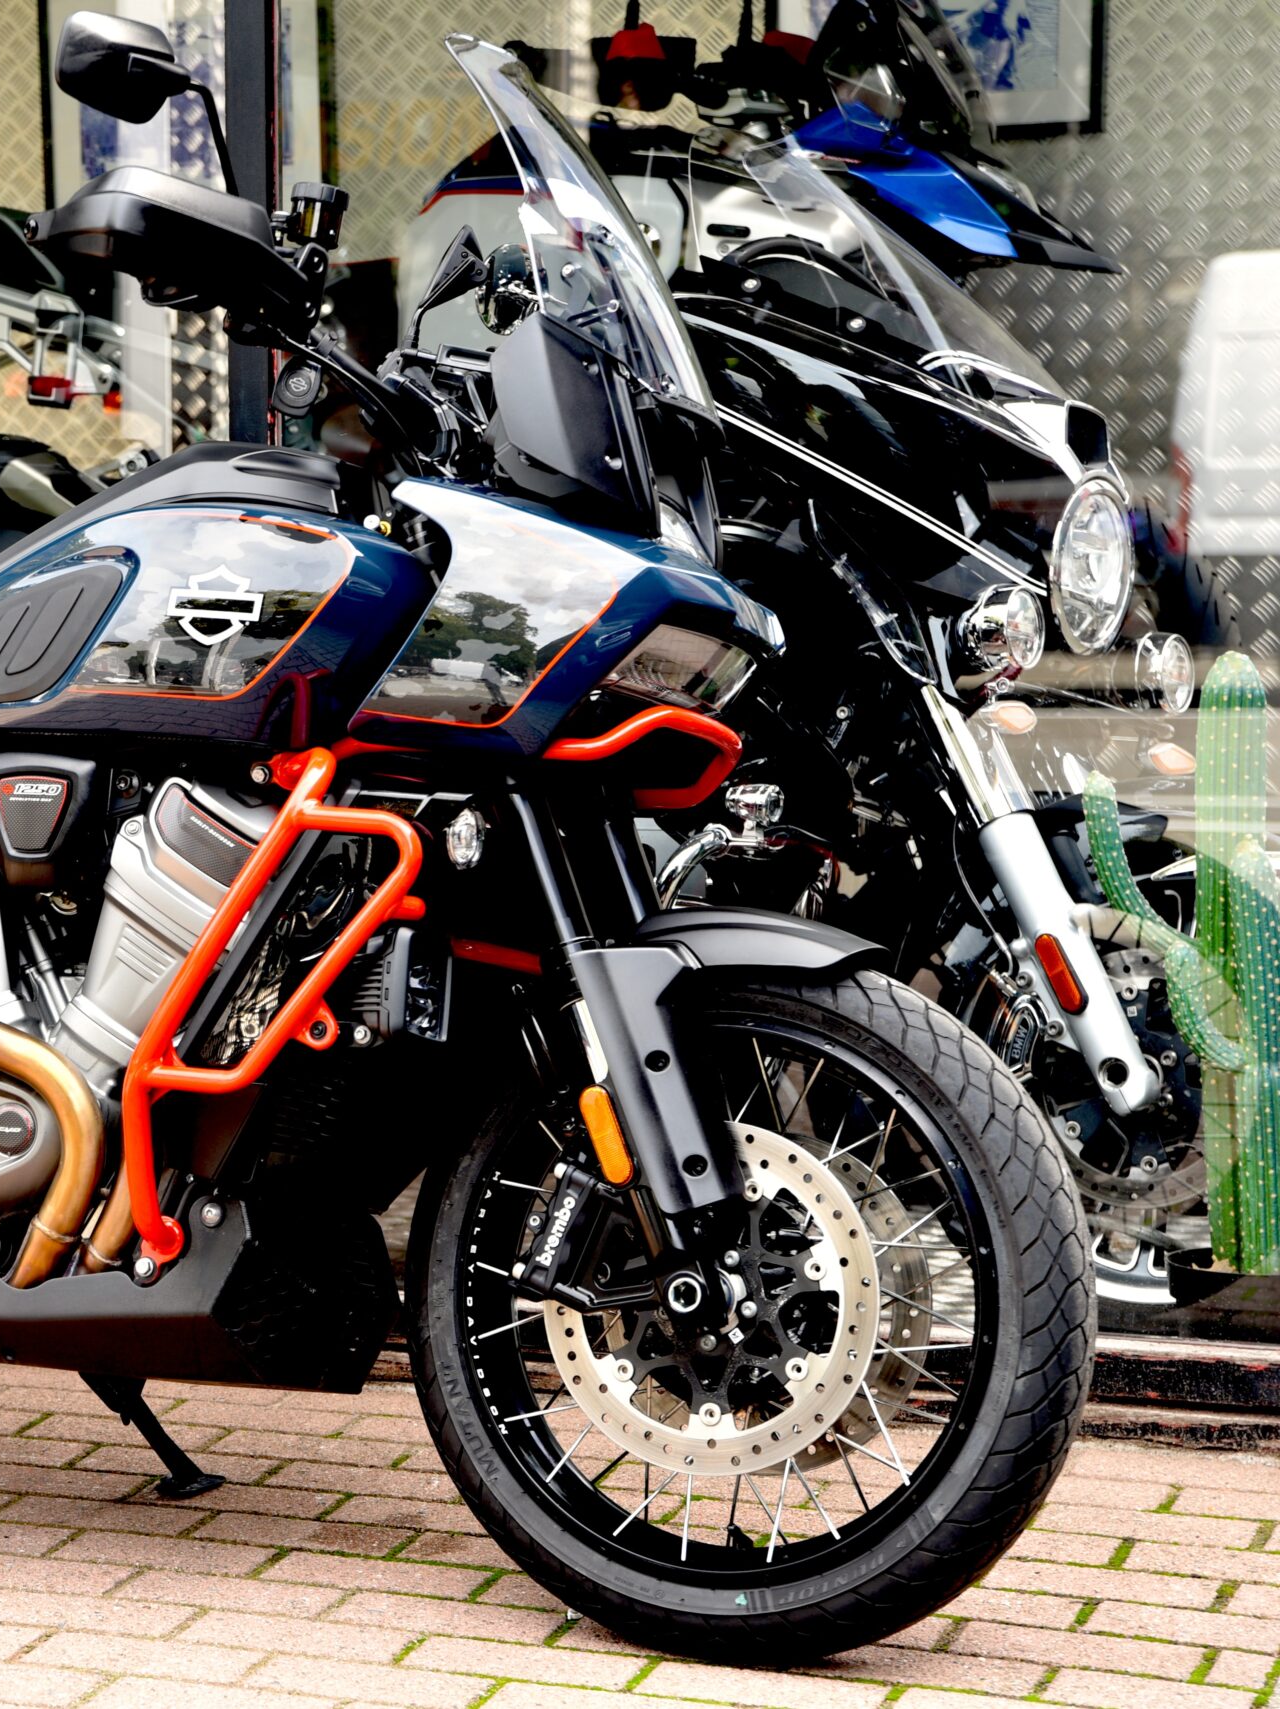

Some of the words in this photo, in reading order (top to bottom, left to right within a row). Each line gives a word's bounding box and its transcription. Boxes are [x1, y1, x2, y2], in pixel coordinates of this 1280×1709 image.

[13, 783, 62, 796] 1250
[1011, 1025, 1028, 1059] BMW
[535, 1196, 576, 1267] brembo
